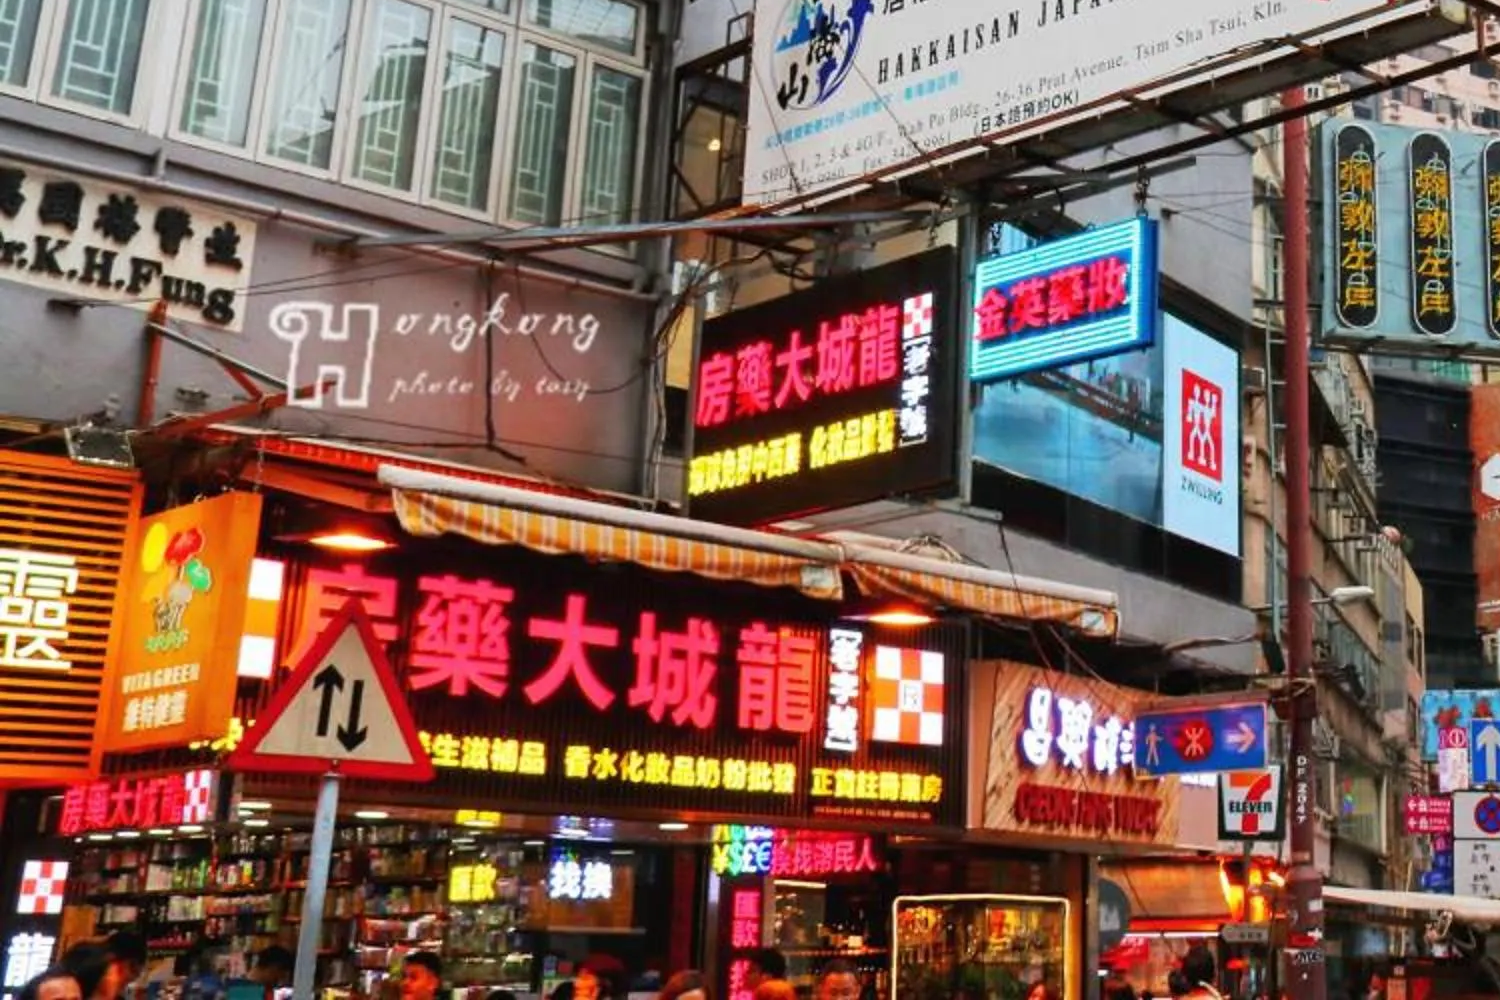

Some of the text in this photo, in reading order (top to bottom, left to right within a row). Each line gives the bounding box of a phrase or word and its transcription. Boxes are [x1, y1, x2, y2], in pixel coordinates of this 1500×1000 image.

[878, 10, 1020, 84] HAKKAISAN
[1175, 28, 1202, 48] Sha
[0, 232, 236, 325] r.K.H.Fung
[1228, 800, 1273, 814] ELEVEN
[548, 861, 613, 900] 找換
